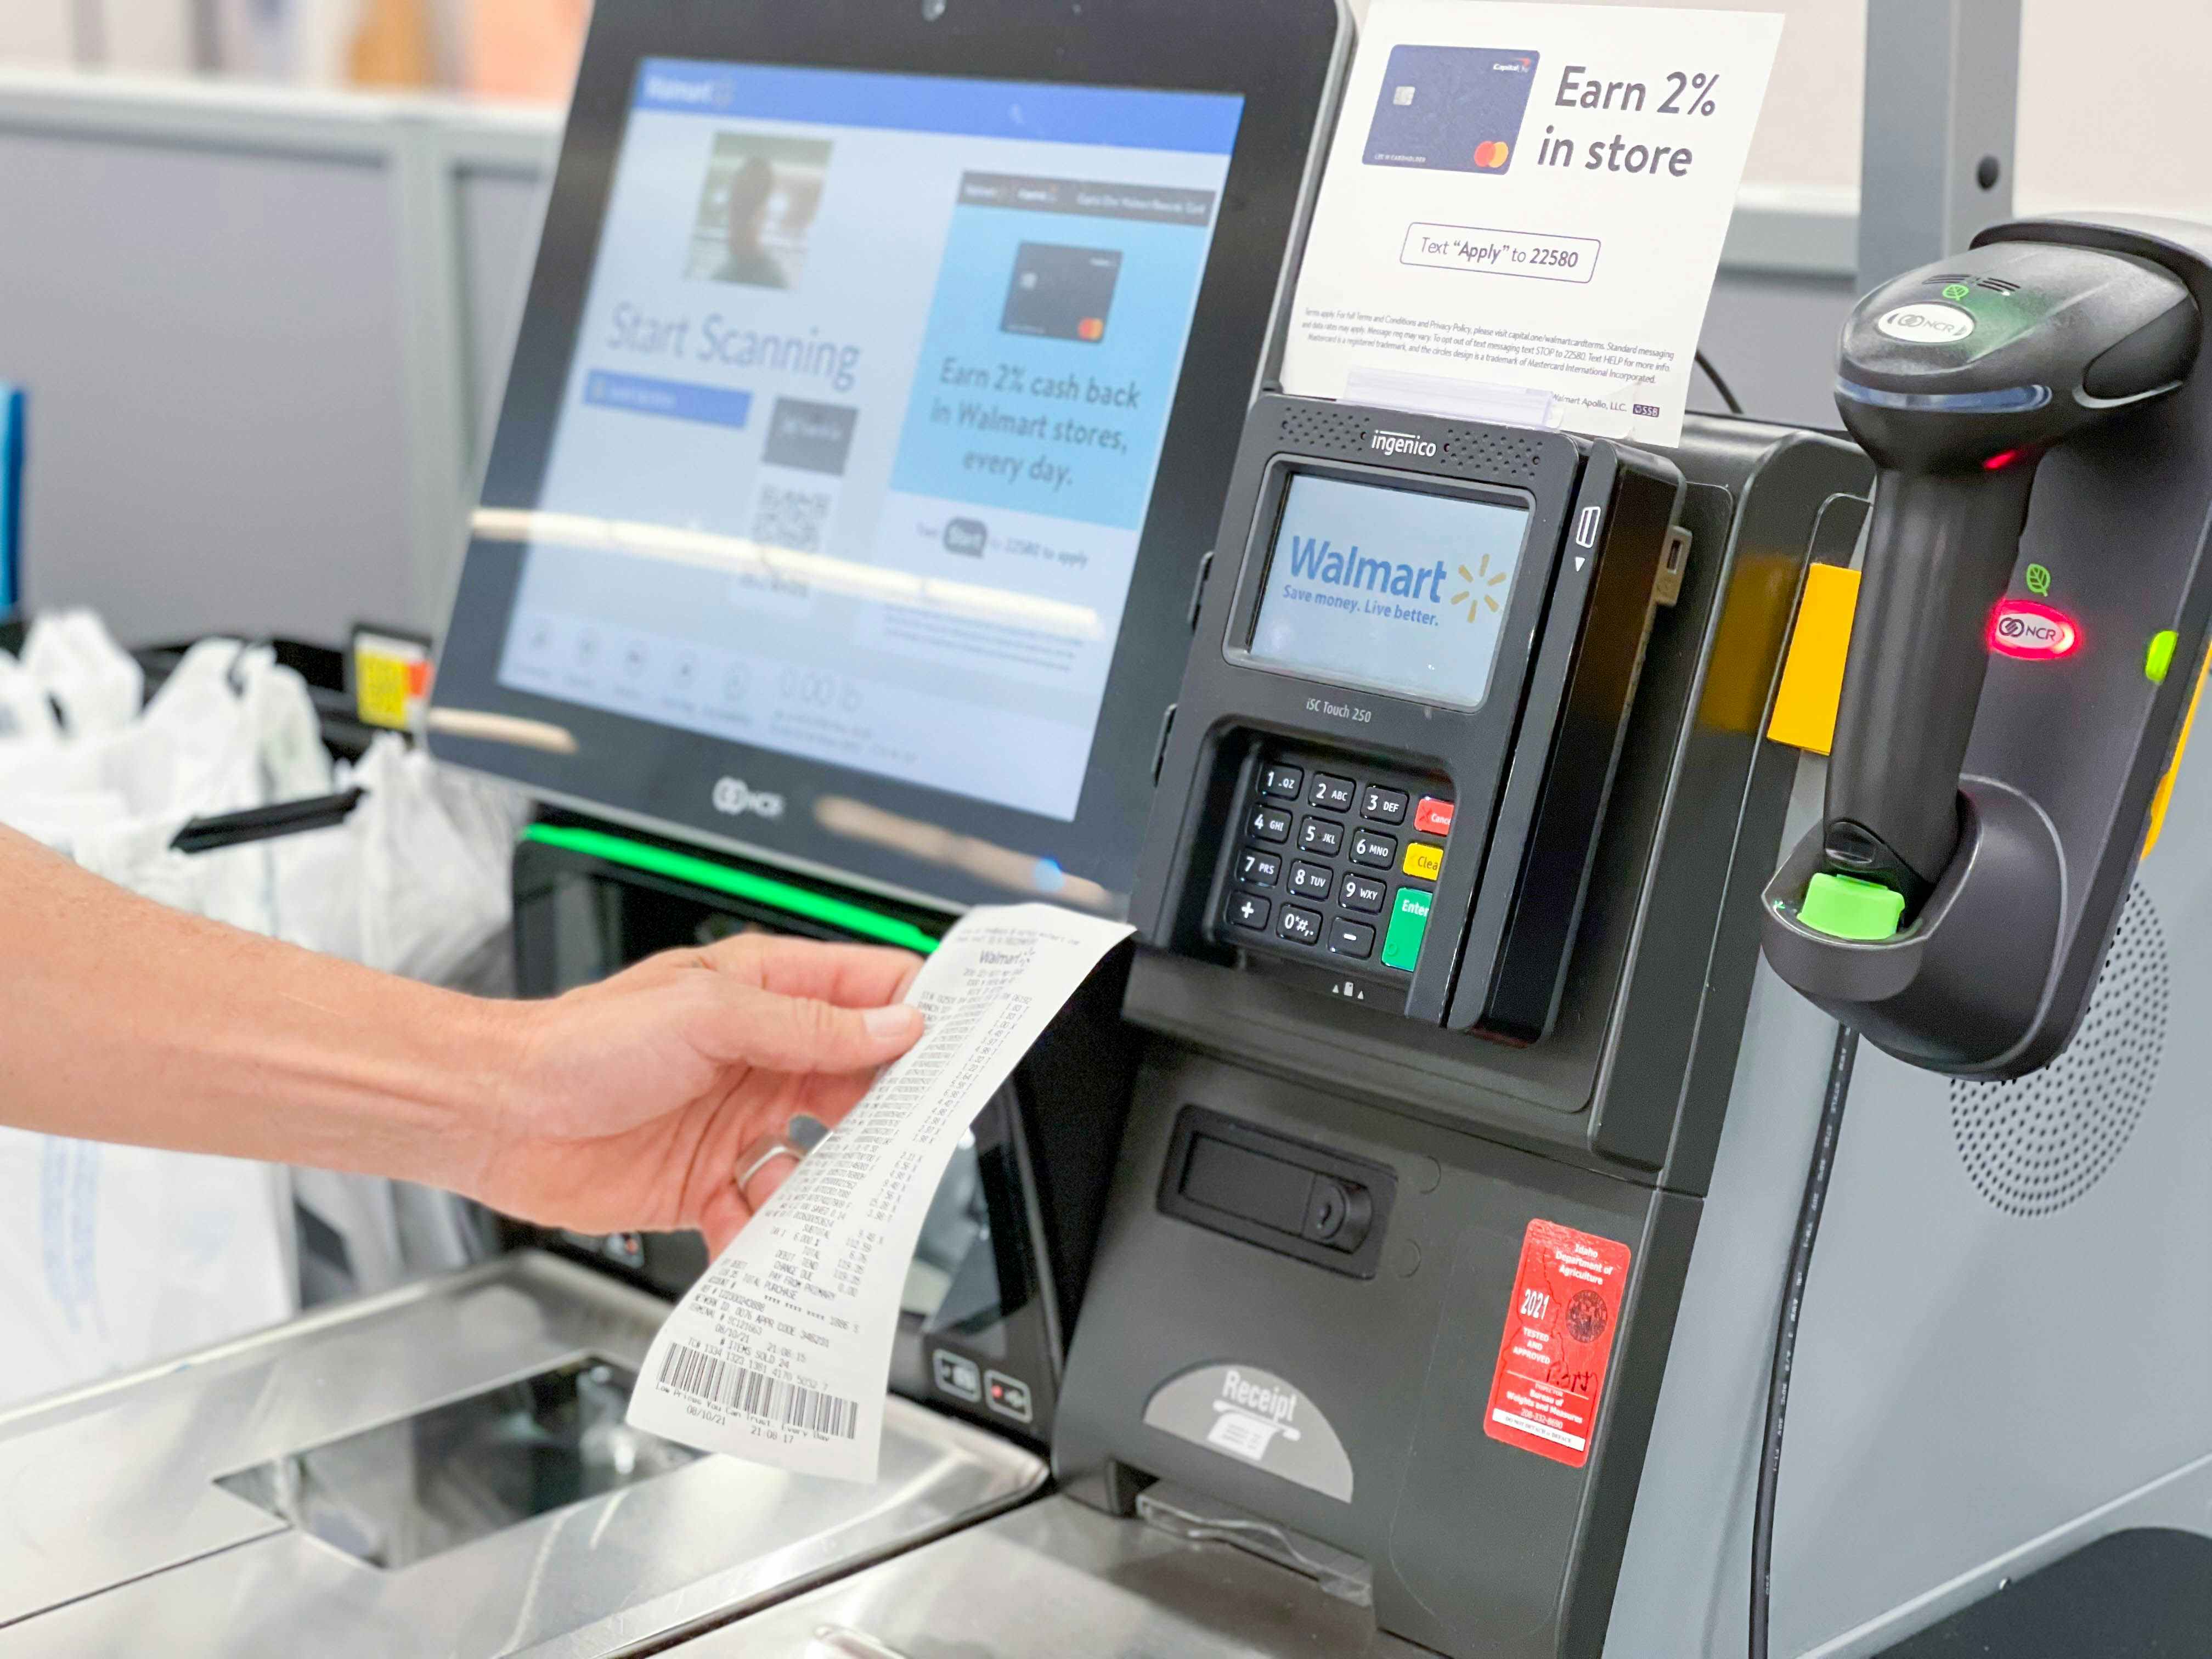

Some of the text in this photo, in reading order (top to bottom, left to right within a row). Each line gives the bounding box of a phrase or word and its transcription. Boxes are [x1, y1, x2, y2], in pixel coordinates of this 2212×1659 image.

[1555, 65, 1719, 116] Earn 2%
[1538, 125, 1692, 177] in store
[1421, 237, 1578, 267] Text “Apply” to 22580
[1924, 320, 1955, 332] NCR
[605, 302, 860, 392] Start Scanning
[1373, 314, 1384, 323] and
[1385, 315, 1416, 327] Conditions
[1418, 319, 1429, 329] and
[1430, 320, 1452, 332] Privacy
[1473, 327, 1494, 336] please
[1495, 329, 1508, 338] visit
[1607, 342, 1637, 355] Standard
[1638, 348, 1674, 360] messaging
[1347, 337, 1375, 347] registered
[1408, 343, 1420, 353] and
[1421, 345, 1431, 354] the
[1432, 347, 1452, 357] circles
[1453, 349, 1473, 360] design
[1475, 352, 1479, 360] is
[1486, 354, 1517, 365] trademark
[1519, 357, 1526, 366] of
[1528, 358, 1564, 371] Mastercard
[1565, 363, 1607, 376] International
[1367, 327, 1391, 337] Message
[1404, 332, 1417, 341] may
[1433, 333, 1441, 342] To
[1441, 336, 1453, 346] opt
[1453, 337, 1464, 346] out
[1465, 337, 1474, 347] of
[1474, 340, 1486, 348] text
[1487, 342, 1520, 354] messaging
[1522, 346, 1534, 355] text
[1536, 347, 1554, 357] STOP
[1588, 353, 1601, 362] Text
[1604, 356, 1622, 365] HELP
[1624, 358, 1634, 367] for
[1635, 362, 1653, 370] more
[940, 357, 1141, 409] Earn 2% cash back
[1582, 398, 1608, 410] Apollo,
[930, 397, 1127, 453] in Walmart stores,
[1372, 431, 1436, 457] ingenico
[963, 452, 1072, 492] every day.
[1291, 535, 1447, 603] Walmart
[1283, 585, 1438, 626] Save money. Live better.
[2026, 626, 2056, 641] NCR
[1306, 697, 1372, 724] iSC Touch 250
[1268, 771, 1274, 787] 1
[1316, 783, 1347, 802] 2 ABC
[1368, 795, 1399, 812] 3 DEF
[1254, 814, 1283, 831] 4 GHI
[1305, 826, 1335, 844] 5 JKL
[1357, 839, 1389, 857] 6 MNO
[1246, 856, 1274, 874] 7 PRS
[1296, 869, 1325, 887] 8 TUV
[1346, 882, 1378, 900] 9 WXY
[1402, 900, 1429, 917] Enter
[1575, 1244, 1598, 1258] Idaho
[1555, 1250, 1613, 1276] Department of
[1559, 1264, 1603, 1285] Agriculture
[1521, 1289, 1550, 1320] 2021
[1524, 1327, 1549, 1342] TESTED
[1513, 1346, 1550, 1364] APPROVED
[1527, 1340, 1543, 1351] AND
[1222, 1370, 1297, 1422] Receipt
[1555, 1398, 1564, 1407] of
[1506, 1391, 1534, 1407] Weights
[1535, 1402, 1549, 1412] and
[1550, 1406, 1583, 1424] Measures
